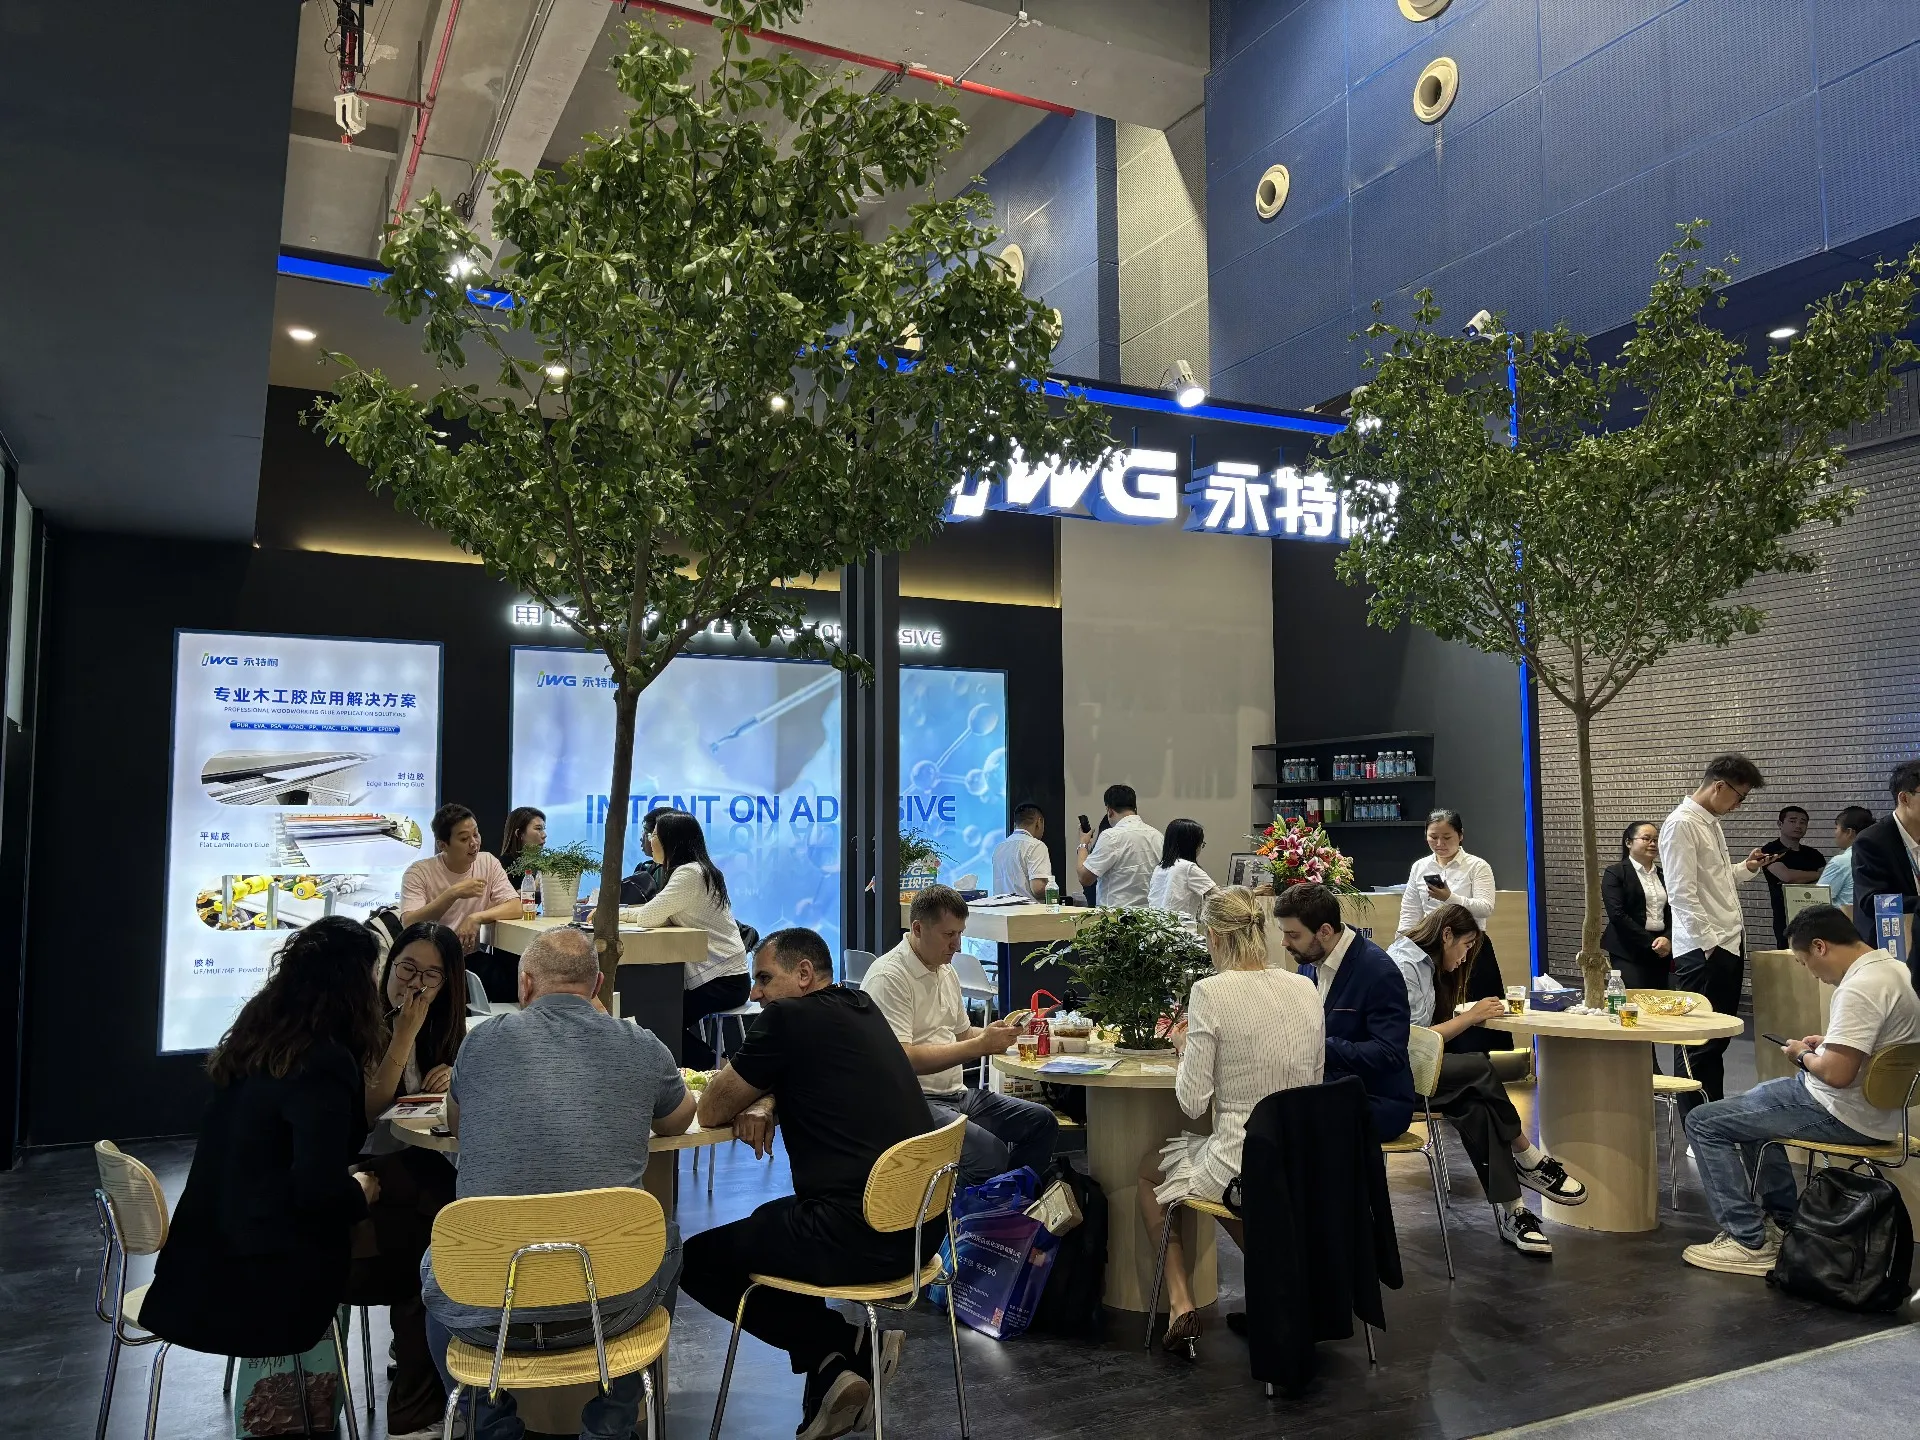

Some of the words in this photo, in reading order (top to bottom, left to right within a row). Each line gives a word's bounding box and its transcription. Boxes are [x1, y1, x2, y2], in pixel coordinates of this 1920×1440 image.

[213, 686, 417, 709] 专业木工胶应用解决方案
[224, 706, 270, 714] PROFESSIONAL
[397, 772, 425, 781] 封边胶
[729, 795, 780, 823] ON
[200, 831, 230, 841] 平贴胶
[193, 958, 214, 967] 胶粉
